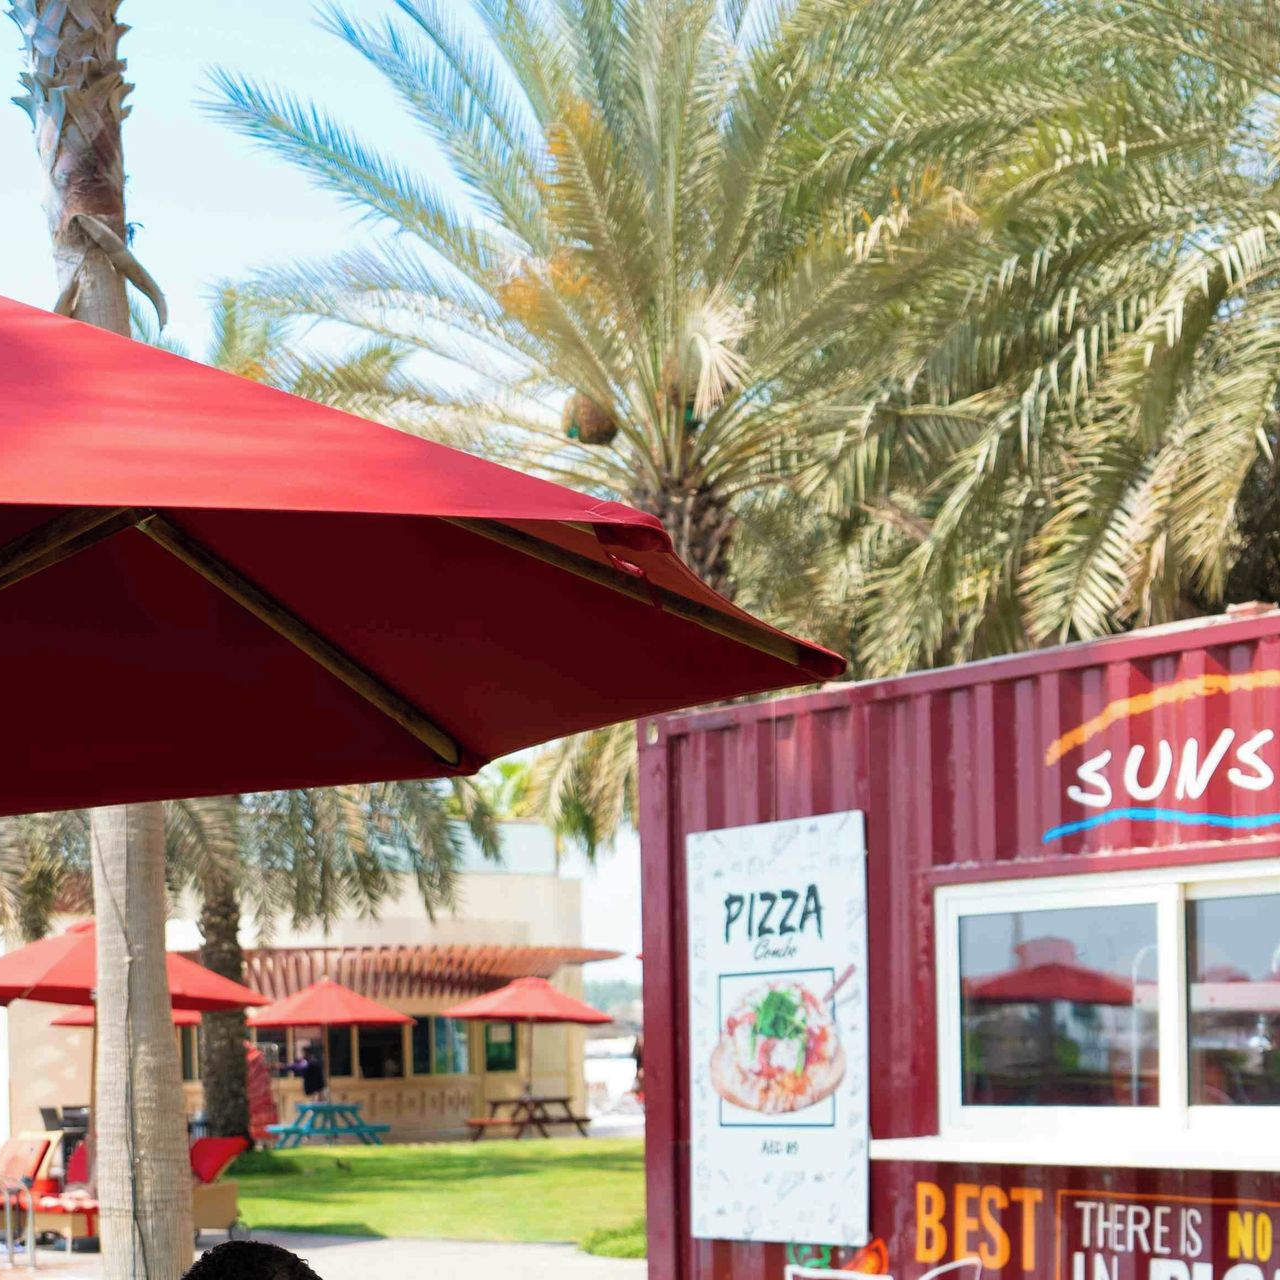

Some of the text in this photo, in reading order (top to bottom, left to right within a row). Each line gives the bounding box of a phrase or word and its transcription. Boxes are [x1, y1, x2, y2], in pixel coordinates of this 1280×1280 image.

[724, 883, 824, 944] PIZZA
[915, 1181, 1044, 1272] BEST
[1075, 1201, 1173, 1255] THERE
[1179, 1207, 1203, 1258] IS
[1227, 1211, 1273, 1262] NO
